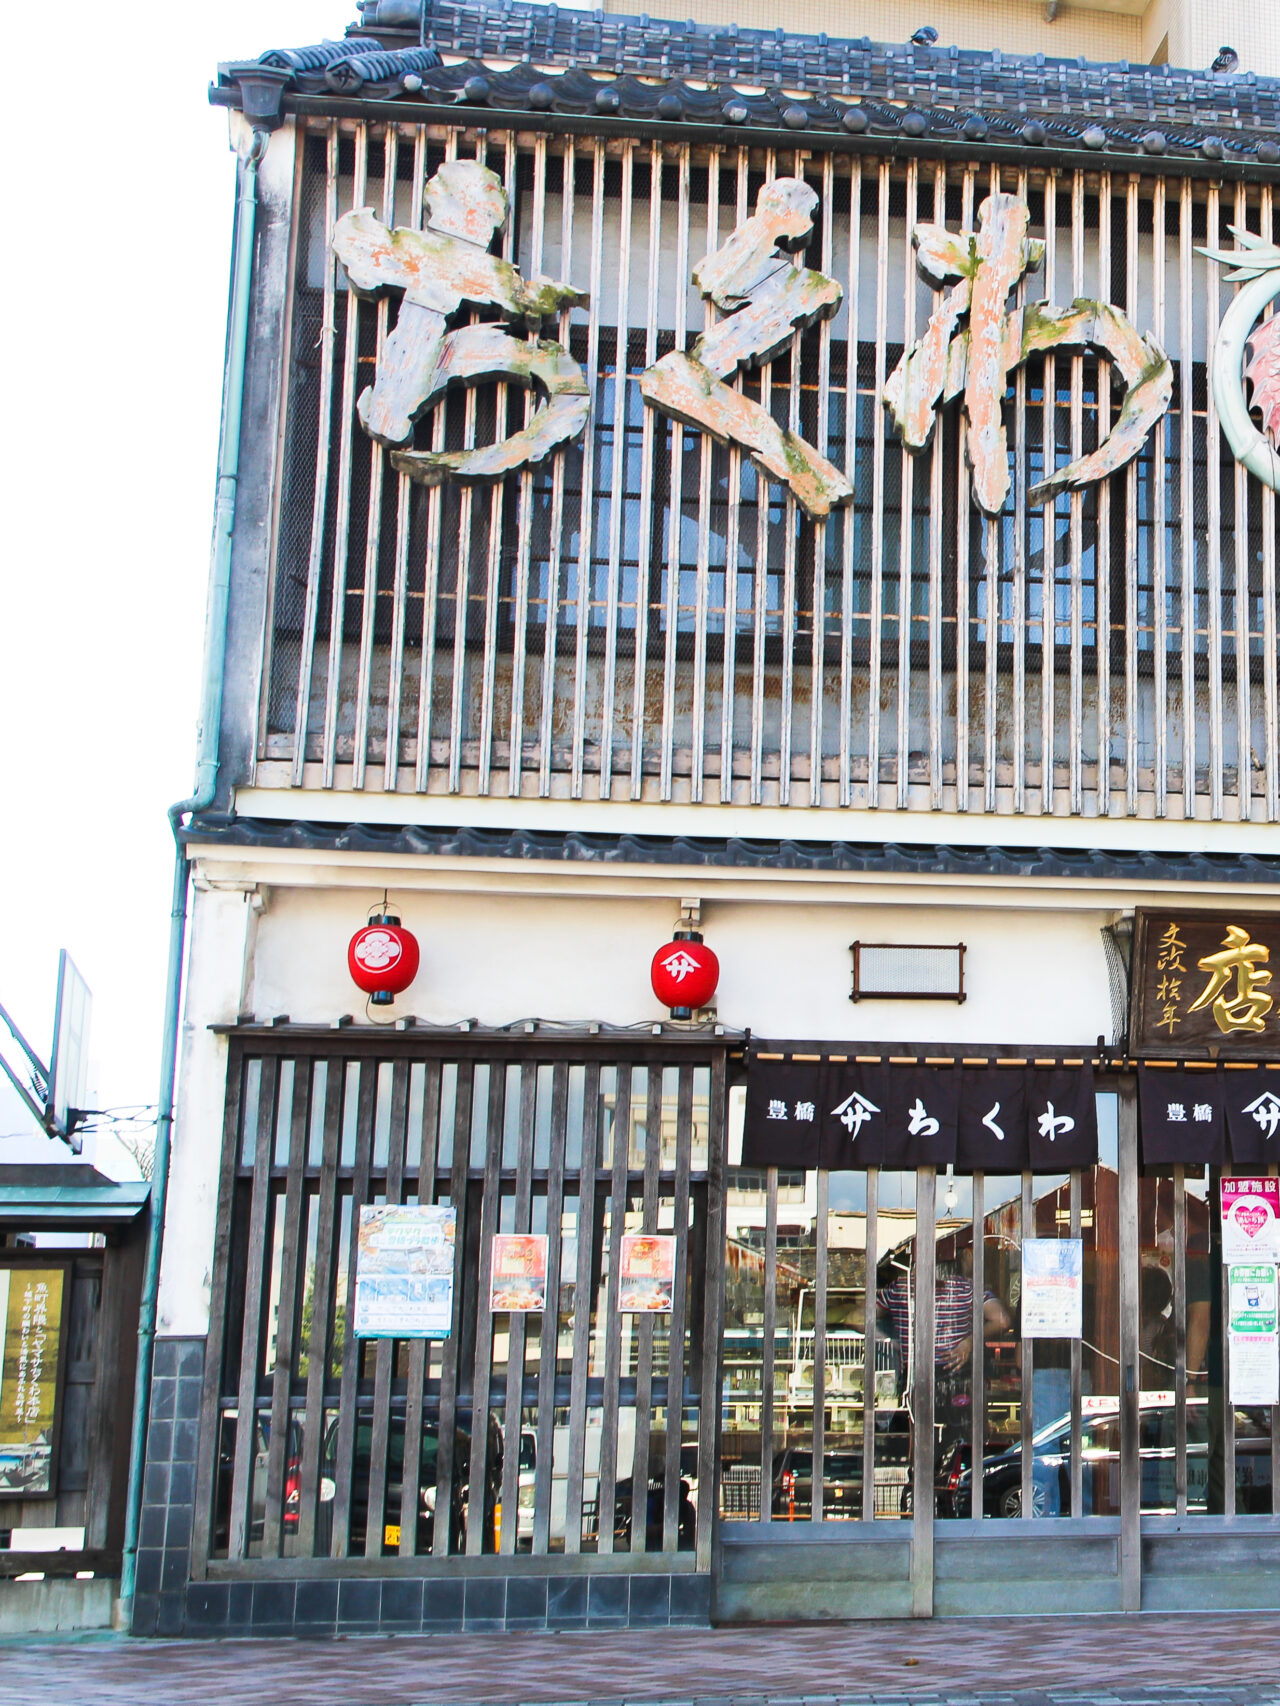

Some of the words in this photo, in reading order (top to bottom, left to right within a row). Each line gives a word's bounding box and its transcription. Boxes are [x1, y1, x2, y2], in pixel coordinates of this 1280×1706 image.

[331, 158, 1174, 522] ちくわ
[1224, 1180, 1277, 1193] 加盟施設
